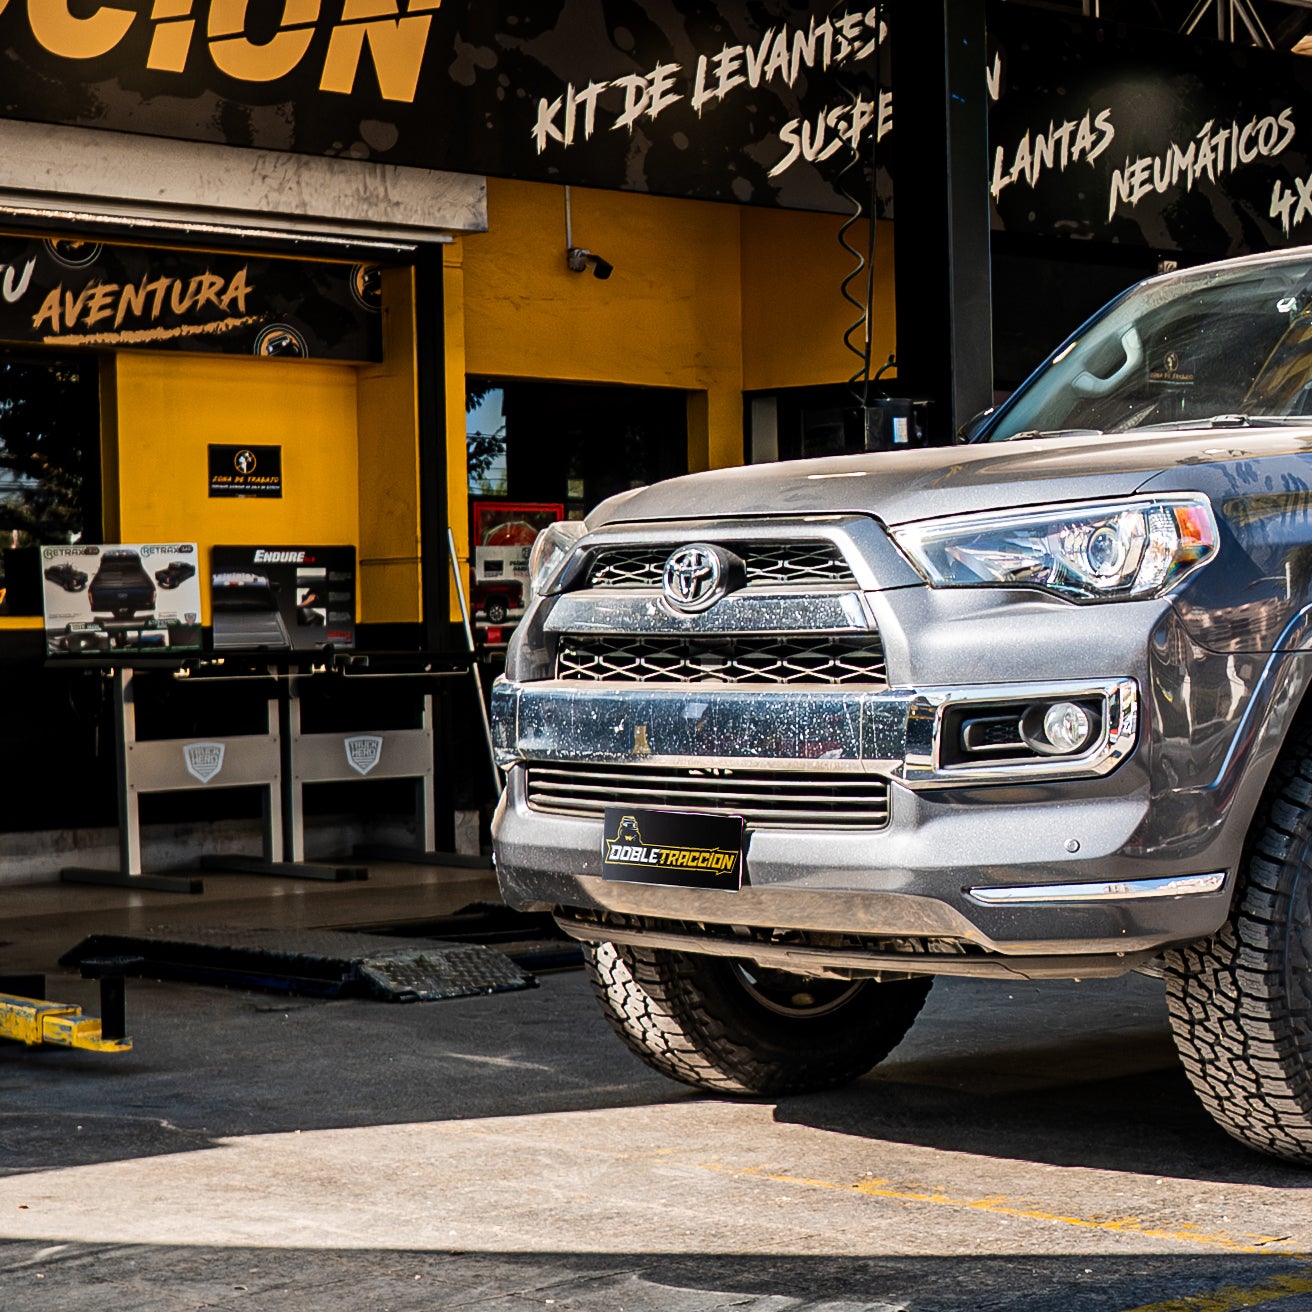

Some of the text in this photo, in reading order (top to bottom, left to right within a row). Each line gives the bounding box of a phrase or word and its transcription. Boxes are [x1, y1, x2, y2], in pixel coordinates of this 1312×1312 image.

[531, 7, 888, 155] KIT DE LEVANTES
[1108, 106, 1296, 223] NEUMÁTICOS
[0, 255, 253, 333] U AVENTURA
[609, 844, 660, 864] DOBLE
